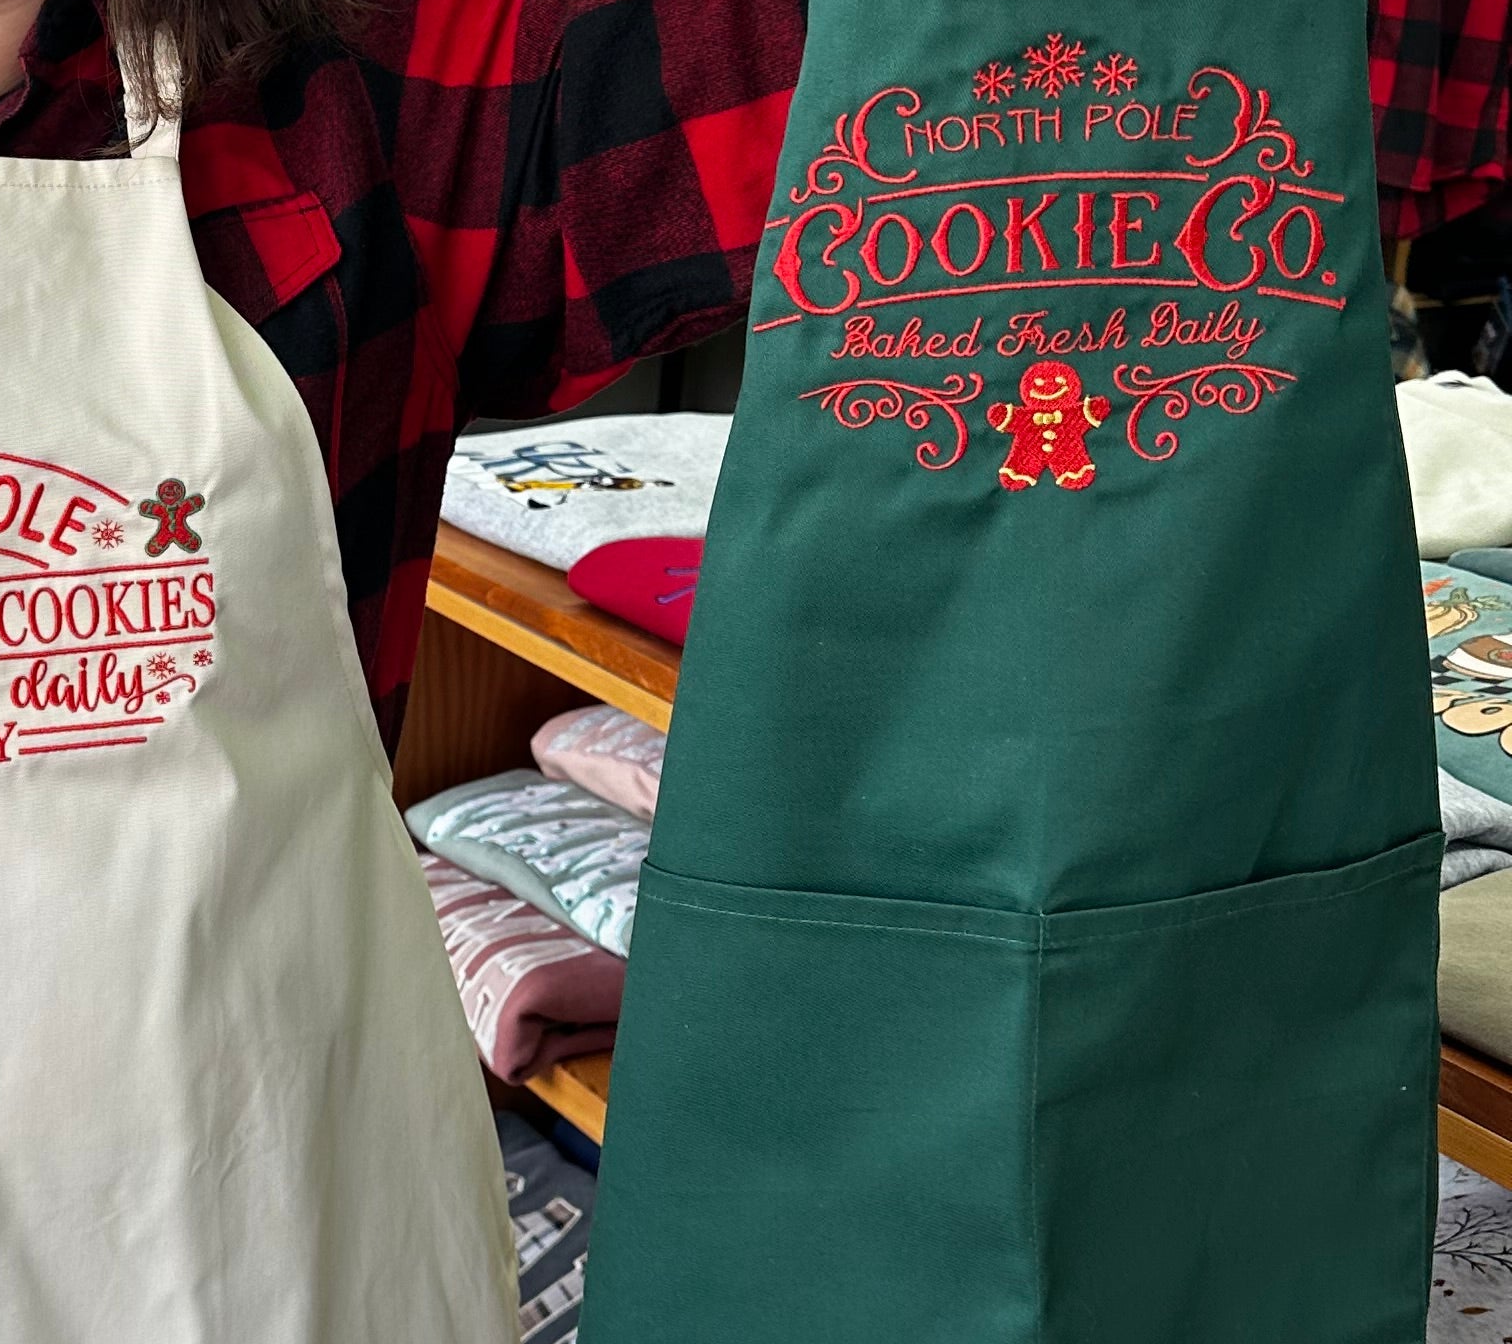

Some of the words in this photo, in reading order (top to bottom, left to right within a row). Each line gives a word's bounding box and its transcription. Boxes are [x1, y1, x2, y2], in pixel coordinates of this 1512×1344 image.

[903, 106, 1063, 157] NORTH
[1086, 102, 1198, 142] POLE
[772, 192, 1162, 316] COOKIE
[831, 315, 982, 360] Baked
[996, 310, 1129, 355] Fresh
[1141, 299, 1265, 360] Daily
[11, 653, 145, 723] daily
